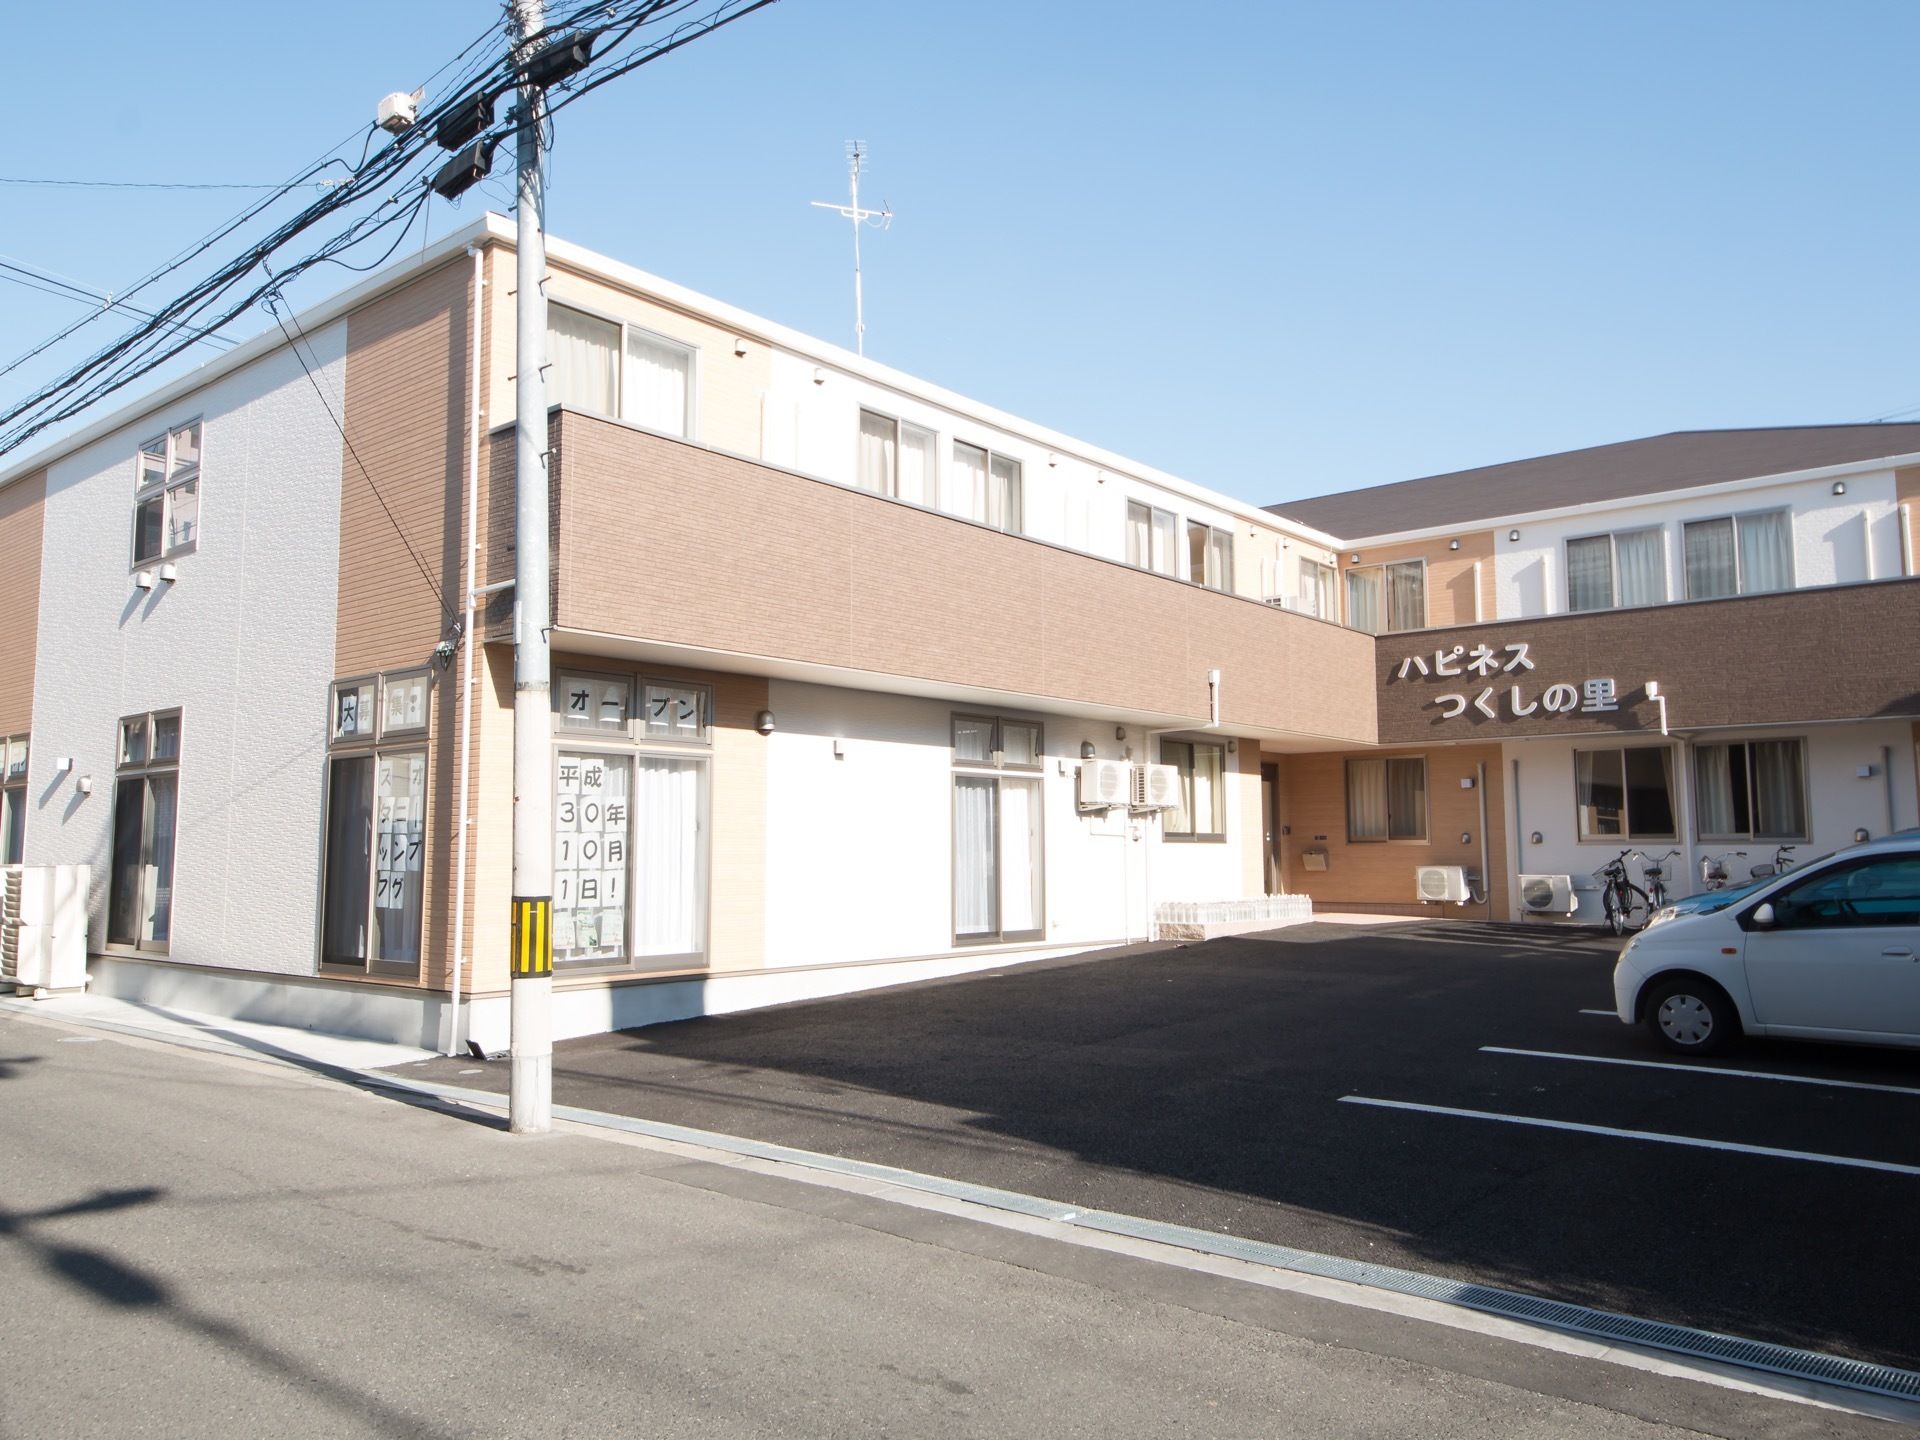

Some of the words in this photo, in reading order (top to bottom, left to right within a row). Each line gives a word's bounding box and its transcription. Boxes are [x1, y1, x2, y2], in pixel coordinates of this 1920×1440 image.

[1398, 643, 1534, 678] ハピネス
[570, 689, 694, 720] オープン
[1434, 678, 1619, 719] つくしの里
[559, 765, 603, 788] 平成
[559, 801, 626, 826] 30年
[562, 839, 623, 863] 10月
